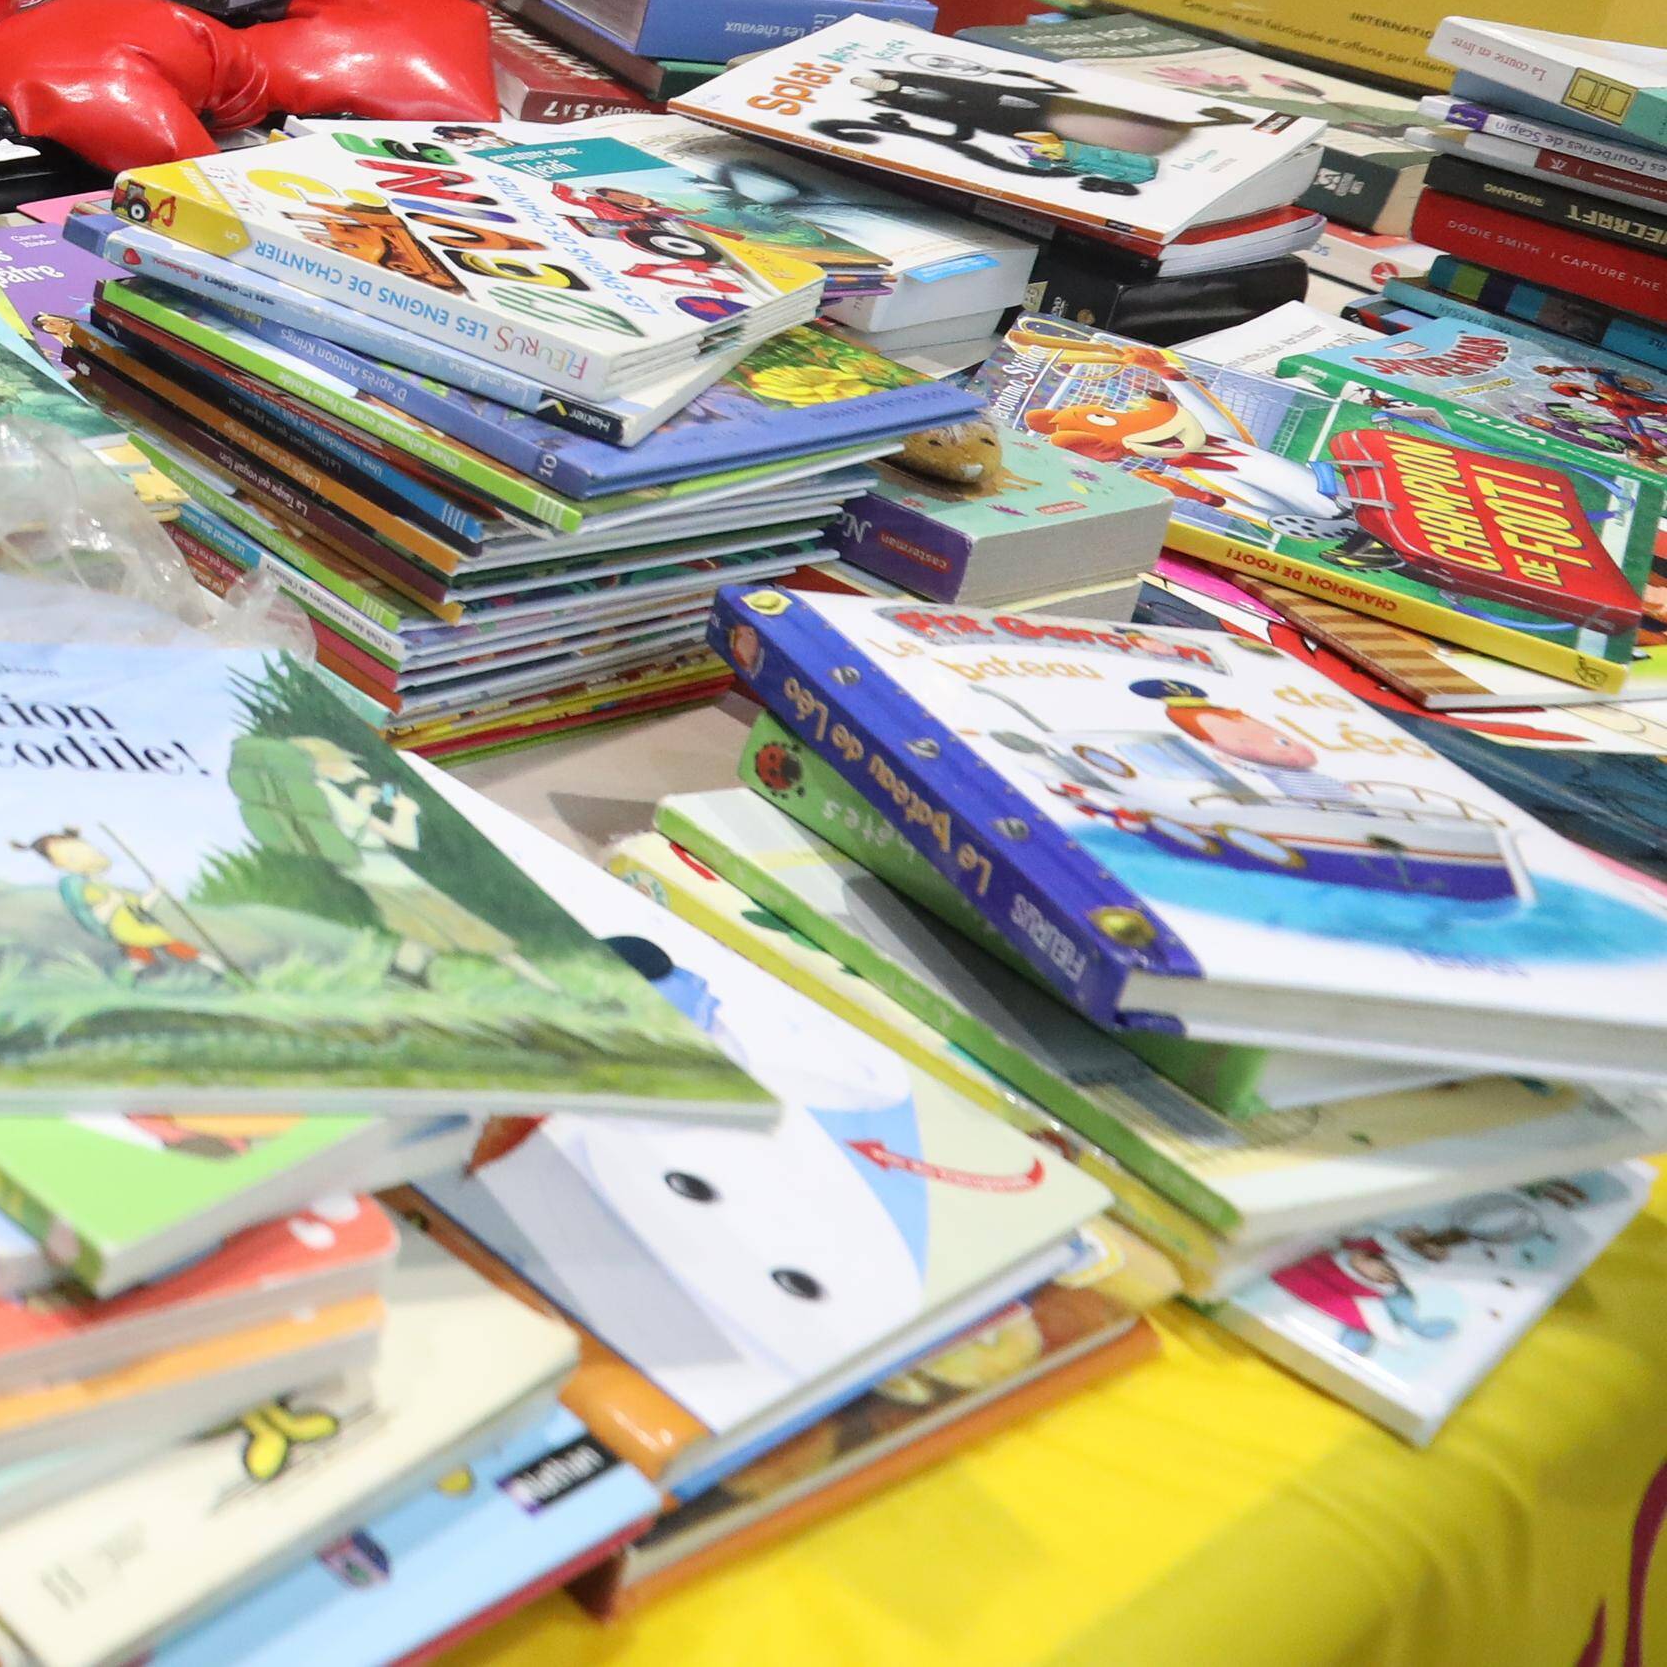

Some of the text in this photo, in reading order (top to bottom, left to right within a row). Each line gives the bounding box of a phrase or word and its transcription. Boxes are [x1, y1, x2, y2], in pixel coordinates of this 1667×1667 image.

[724, 21, 783, 37] chevaux
[1266, 18, 1321, 47] fabriquée
[1323, 35, 1342, 48] et
[1343, 38, 1382, 61] offerte
[1386, 50, 1410, 69] par
[1451, 36, 1548, 82] La course en livre
[747, 61, 843, 117] Splat
[543, 101, 587, 119] 5 7
[492, 145, 584, 166] aventure avec
[1495, 120, 1648, 175] Fourberies de Scapin
[526, 158, 578, 179] Heidi
[1484, 182, 1534, 207] MOJANG
[254, 240, 344, 285] CHANTIER
[488, 171, 658, 317] LES ENGINS DE CHANTIER
[1446, 219, 1491, 239] DODIE
[1496, 233, 1542, 256] SMITH
[1560, 253, 1628, 282] CAPTURE
[1633, 273, 1661, 292] THE
[347, 276, 373, 296] DE
[376, 290, 452, 328] ENGINS
[279, 324, 320, 361] Krings
[453, 316, 489, 343] LES
[318, 343, 362, 381] Antoon
[496, 324, 591, 382] FLEURUS
[1352, 331, 1513, 379] SPIDER-MAN
[278, 368, 316, 400] froide
[360, 366, 408, 404] D'après
[343, 399, 377, 430] craint
[566, 405, 613, 434] Hatier
[1451, 407, 1549, 447] verte
[427, 442, 461, 474] Chat
[538, 453, 558, 478] 10
[270, 483, 309, 517] La Taupe
[1387, 433, 1499, 572] CHAMPION
[1464, 463, 1578, 588] DE FOOT!
[880, 533, 952, 573] casterman
[1225, 546, 1398, 613] CHAMPION DE FOOT!
[867, 636, 1104, 683] Le bateau
[1275, 685, 1356, 713] de
[783, 674, 994, 898] Le bateau de Léo
[1010, 893, 1087, 983] FLEURUS
[519, 1443, 602, 1516] Nathan
